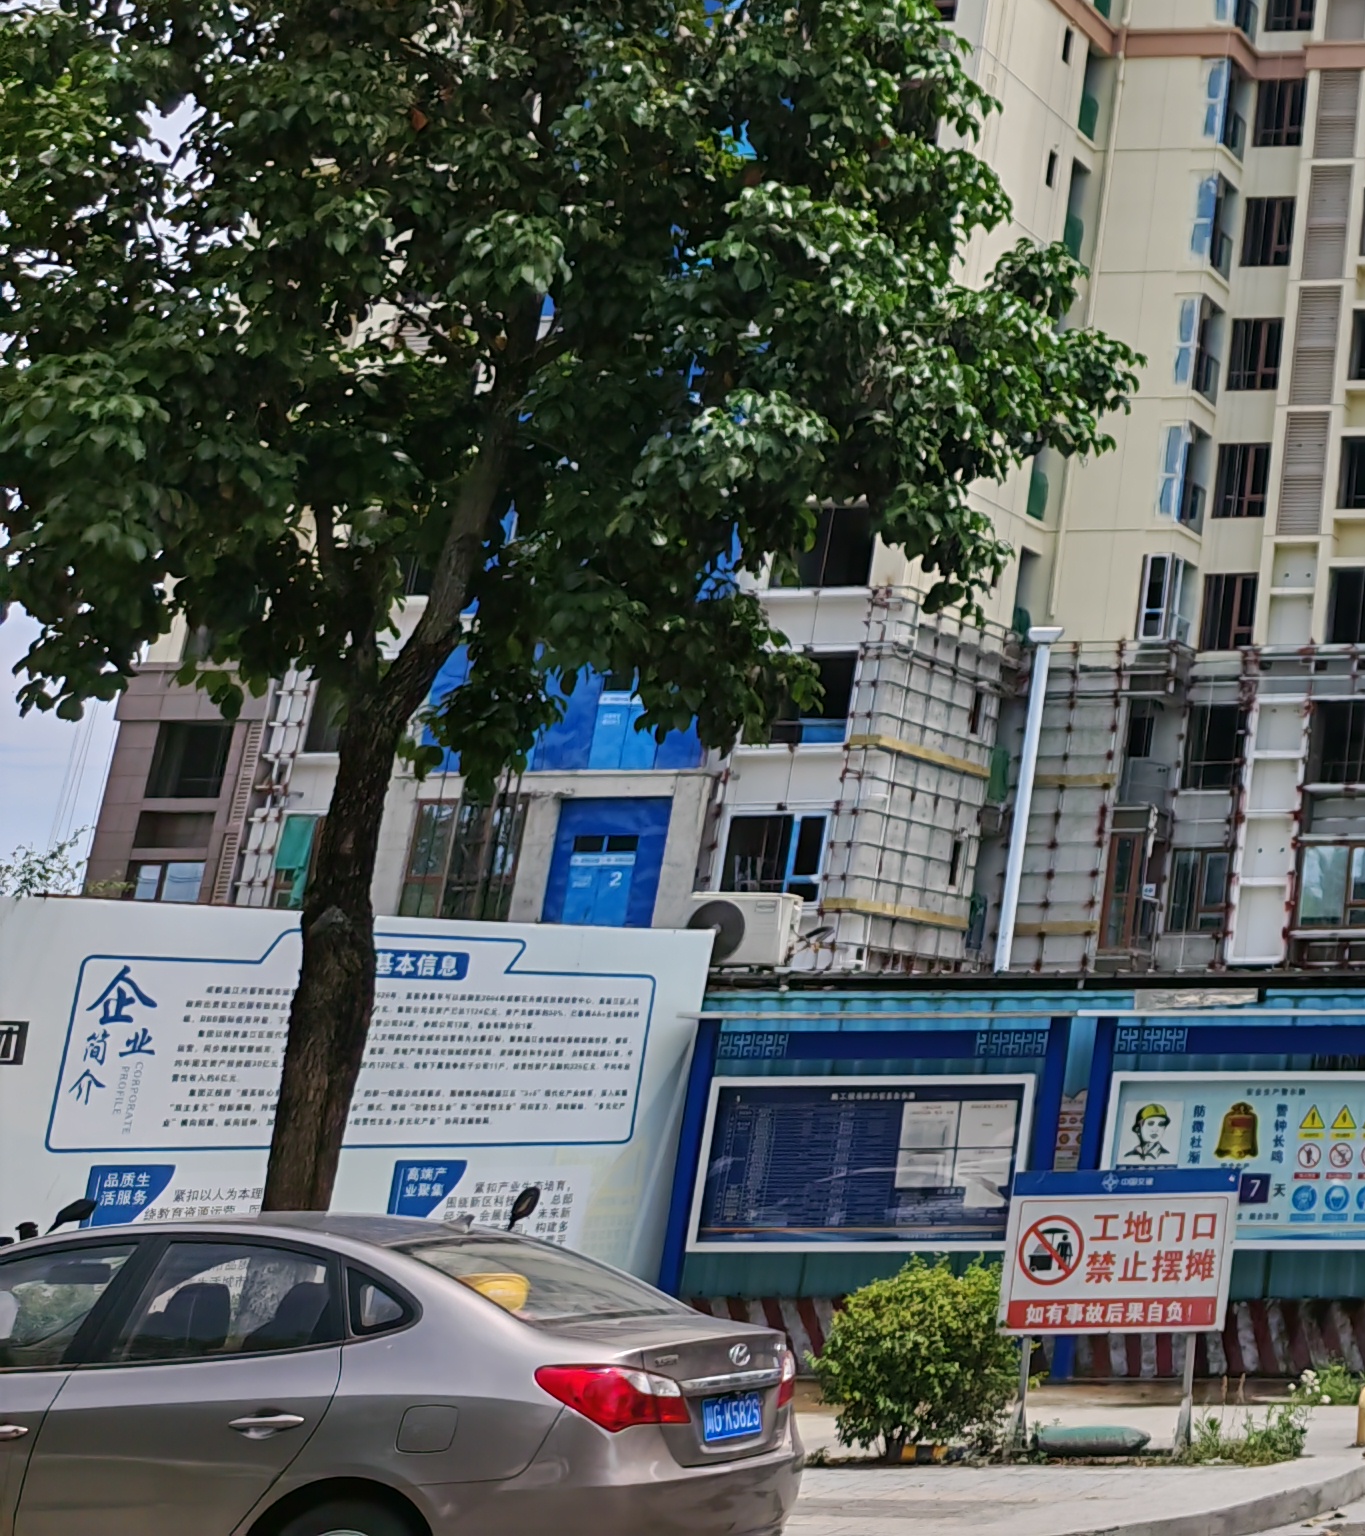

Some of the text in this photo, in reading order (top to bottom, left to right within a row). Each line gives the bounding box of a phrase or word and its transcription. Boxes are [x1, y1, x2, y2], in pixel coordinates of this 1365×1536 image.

[609, 871, 622, 887] 2
[376, 952, 459, 977] 基本信息
[111, 1061, 144, 1135] CORPORATE PROFILE
[1270, 1103, 1289, 1164] 警钟长鸣
[103, 1172, 151, 1188] 品质生
[406, 1167, 448, 1181] 高端产
[100, 1190, 148, 1206] 活服务
[1249, 1179, 1287, 1197] 7 天
[1089, 1210, 1218, 1244] 工地门口
[1085, 1248, 1217, 1284] 禁止摆摊
